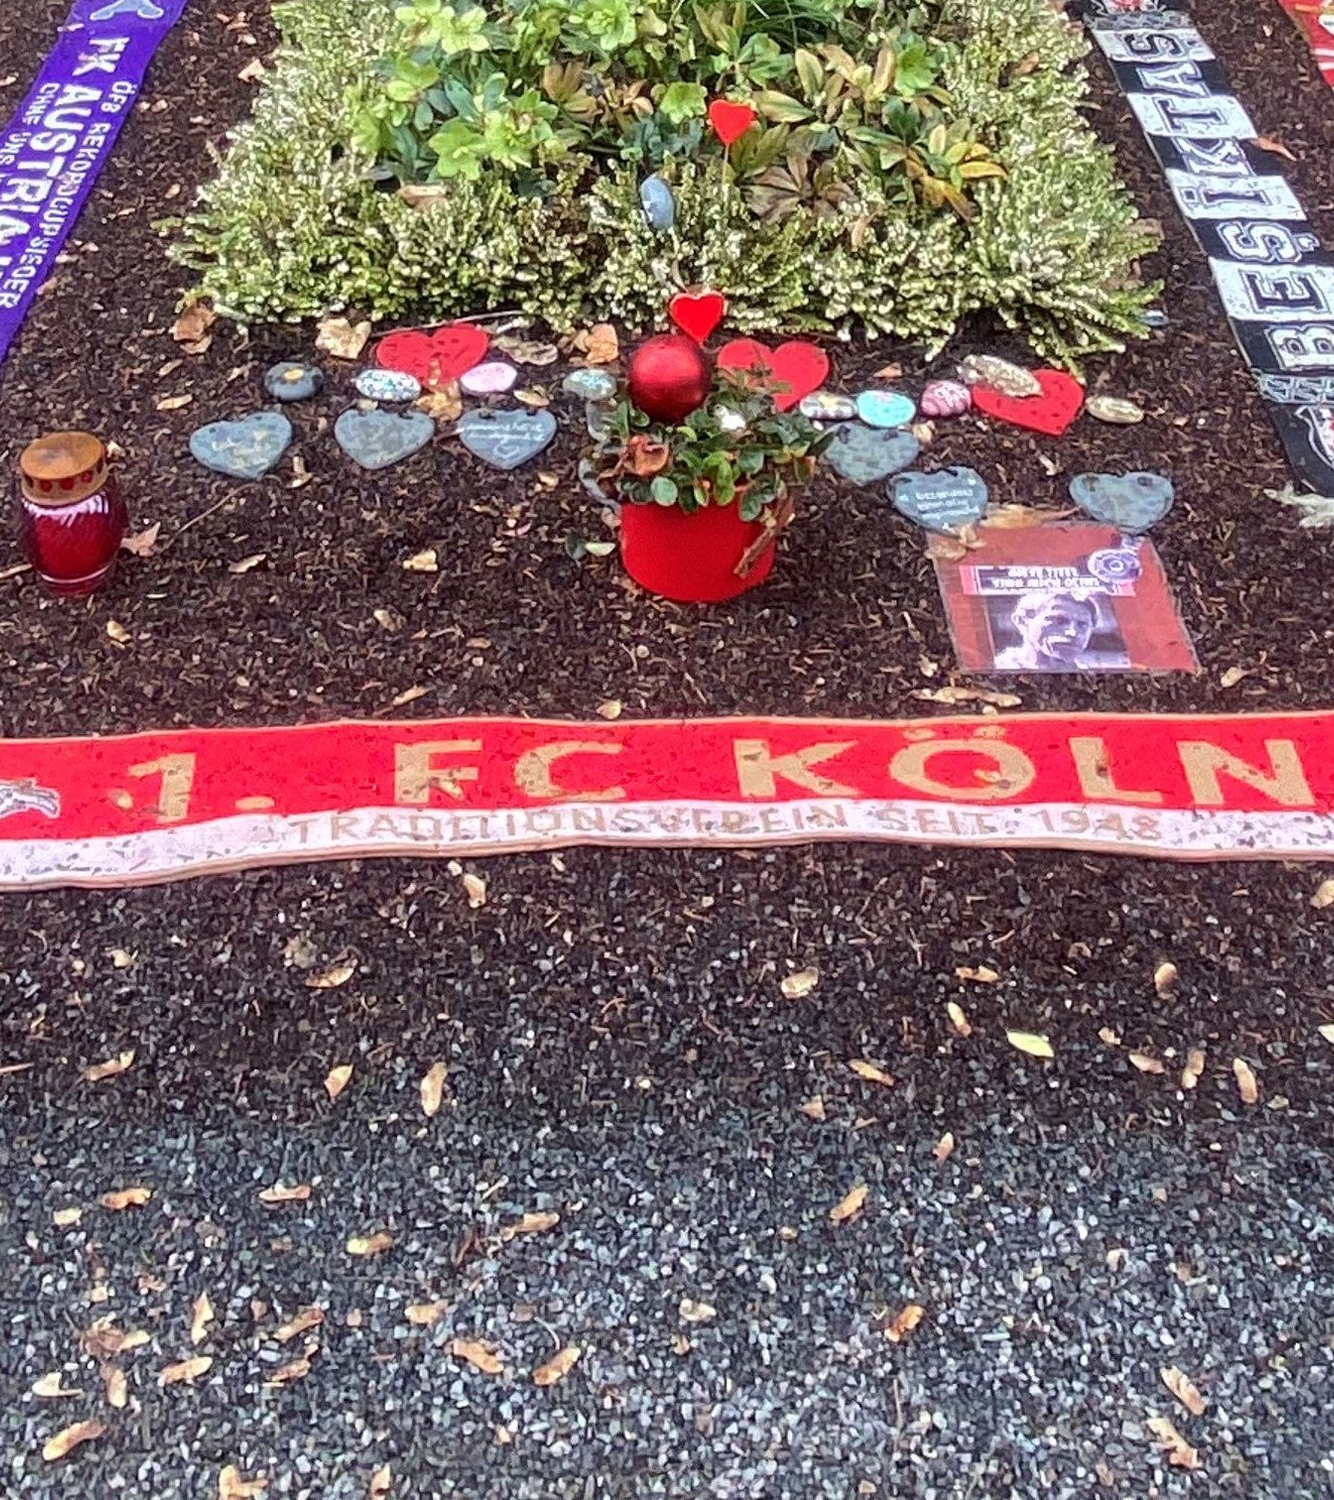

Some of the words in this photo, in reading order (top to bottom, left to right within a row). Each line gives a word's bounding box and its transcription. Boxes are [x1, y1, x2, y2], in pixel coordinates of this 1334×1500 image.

[72, 37, 130, 76] FK
[101, 81, 138, 113] ÖFB
[394, 738, 627, 805] FC
[732, 724, 1315, 806] KÖLN
[875, 807, 999, 833] SEIT
[1034, 809, 1163, 840] 1948
